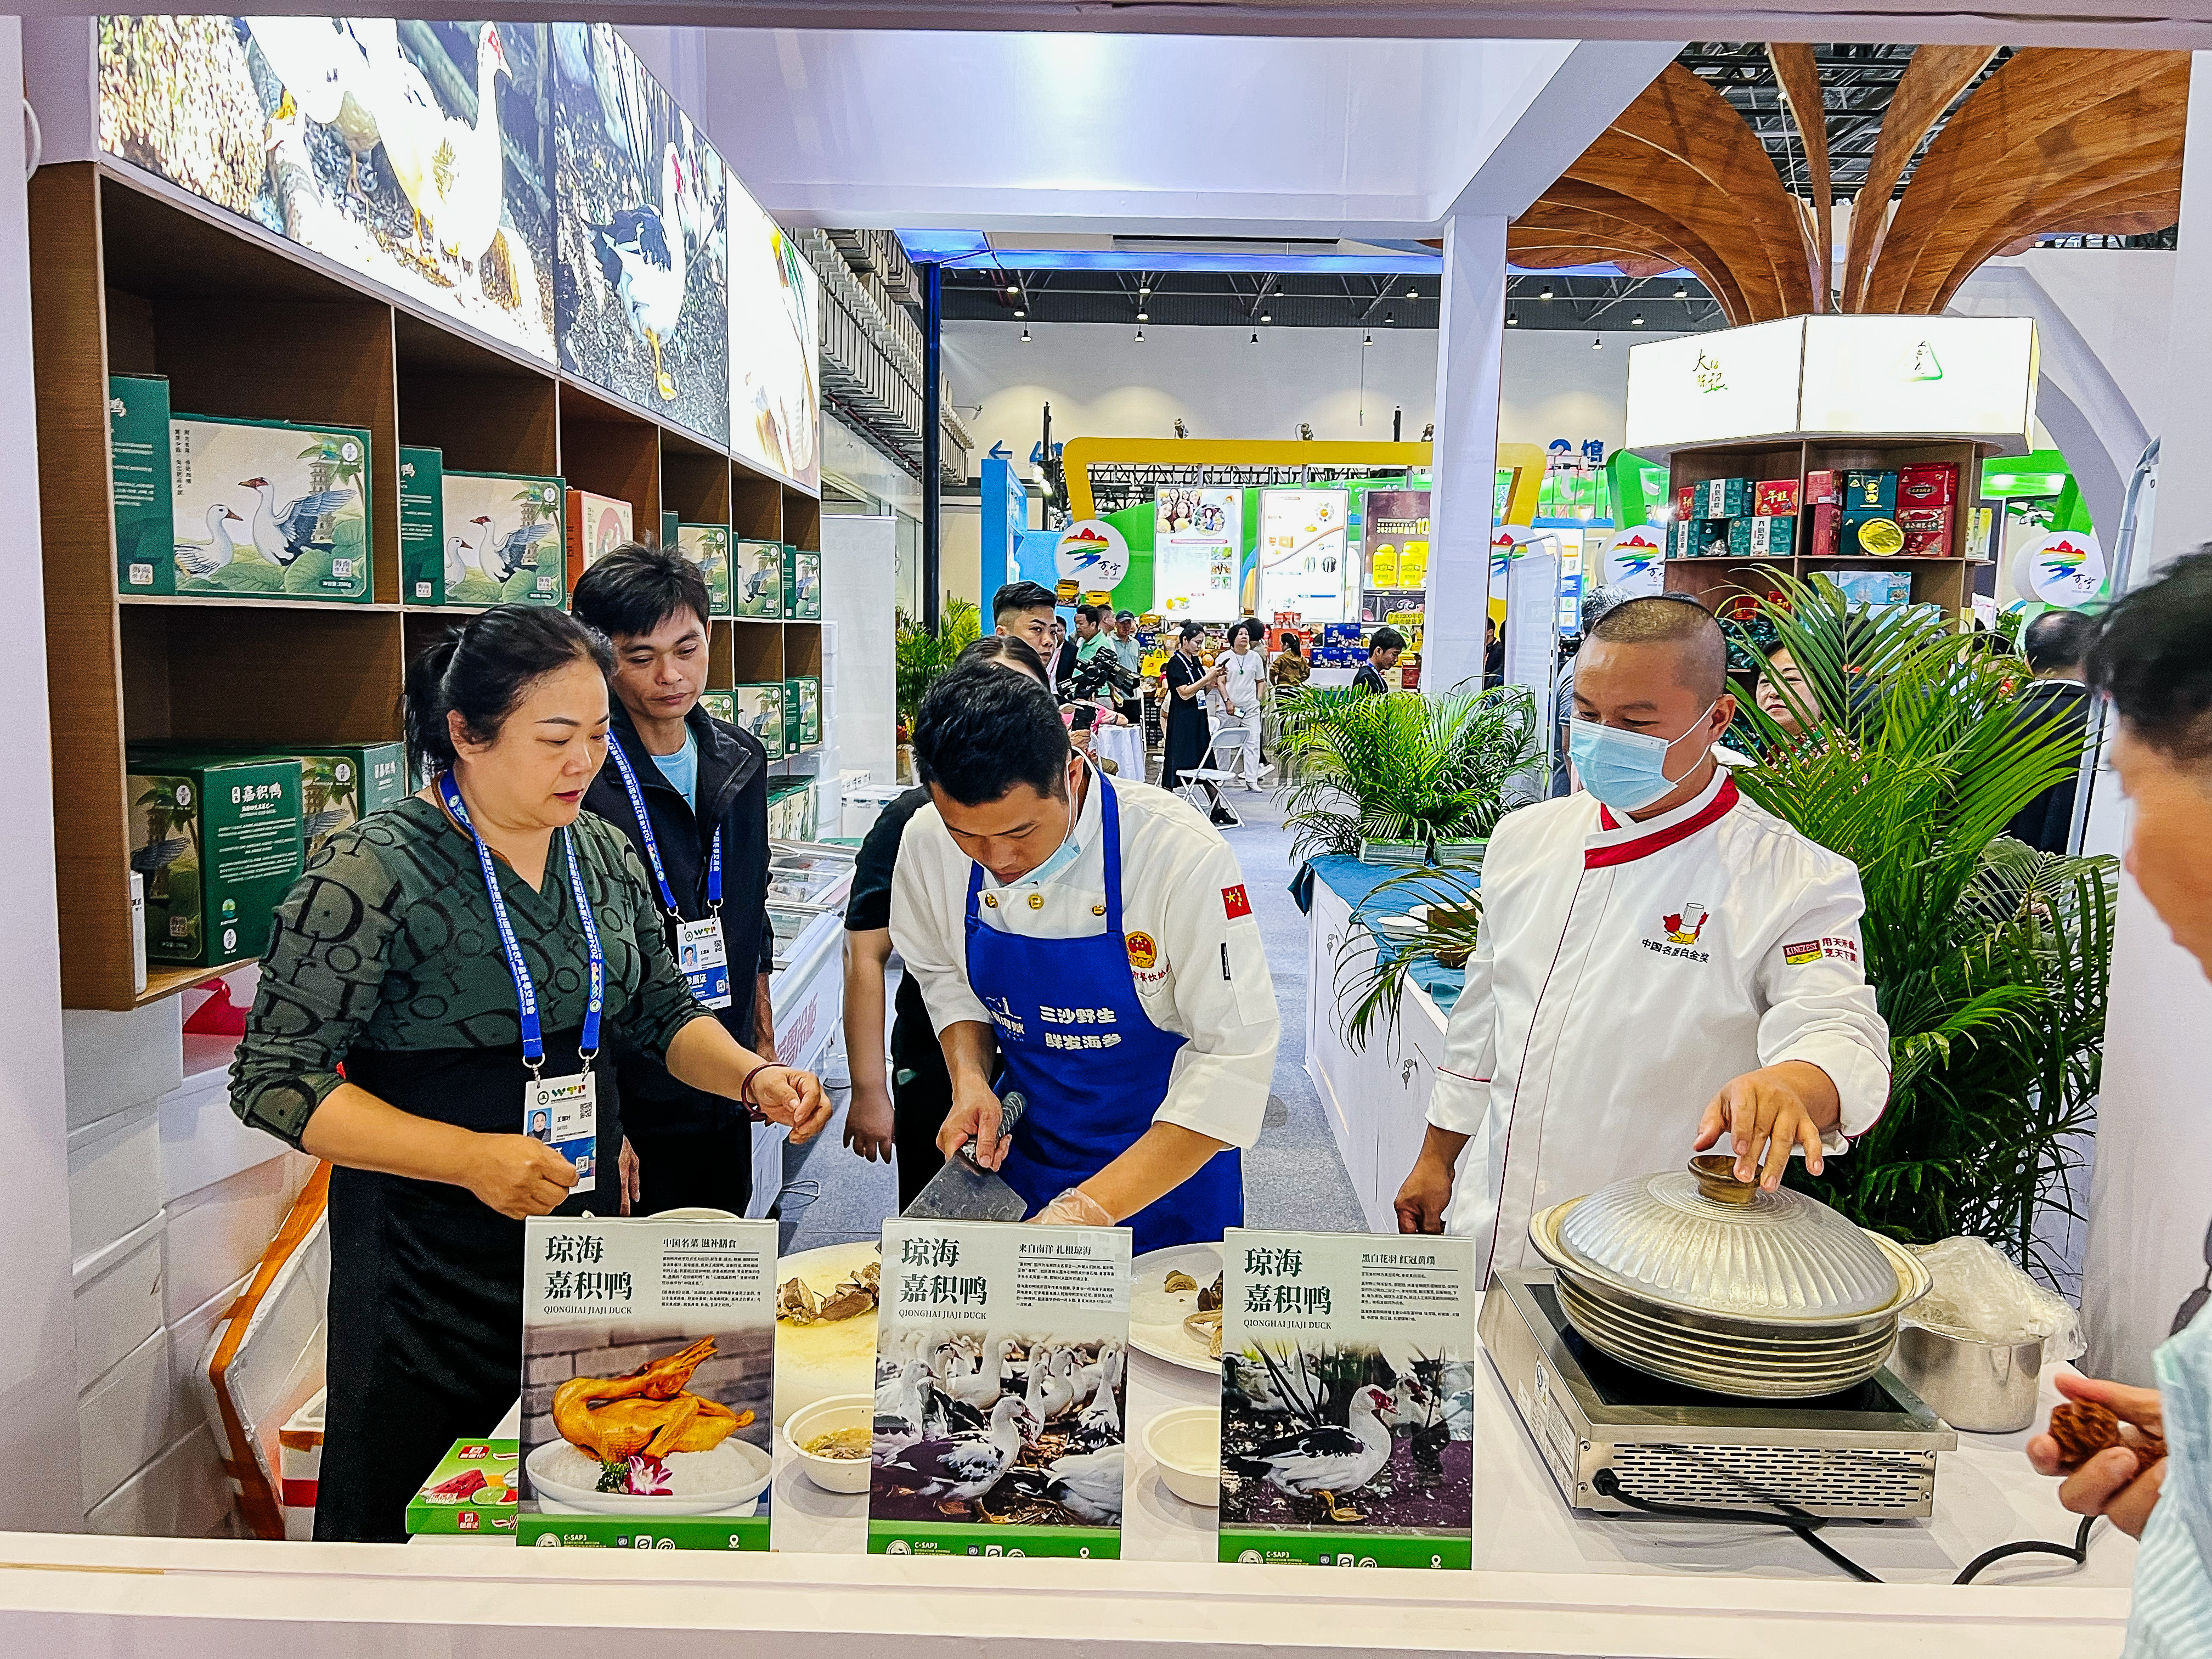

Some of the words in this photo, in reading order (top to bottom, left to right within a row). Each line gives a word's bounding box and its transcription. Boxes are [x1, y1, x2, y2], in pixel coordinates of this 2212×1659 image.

[1040, 1006, 1117, 1024] 三沙野生
[545, 1234, 604, 1264] 琼海
[663, 1238, 698, 1248] 中国名菜
[901, 1237, 960, 1268] 琼海
[1019, 1243, 1054, 1254] 来自南洋
[1056, 1245, 1092, 1255] 扎根琼海
[1244, 1247, 1304, 1278] 琼海
[544, 1271, 633, 1300] 嘉积鸭
[899, 1273, 988, 1306] 嘉积鸭
[544, 1306, 586, 1314] QIONGHAI
[588, 1306, 607, 1314] JIAJI
[1243, 1283, 1332, 1315] 嘉积鸭
[898, 1309, 941, 1318] QIONGHAI
[942, 1311, 962, 1319] JIAJI
[1243, 1319, 1286, 1329] QIONGHAI
[1287, 1320, 1306, 1330] JIAJI
[1308, 1322, 1332, 1330] DUCK
